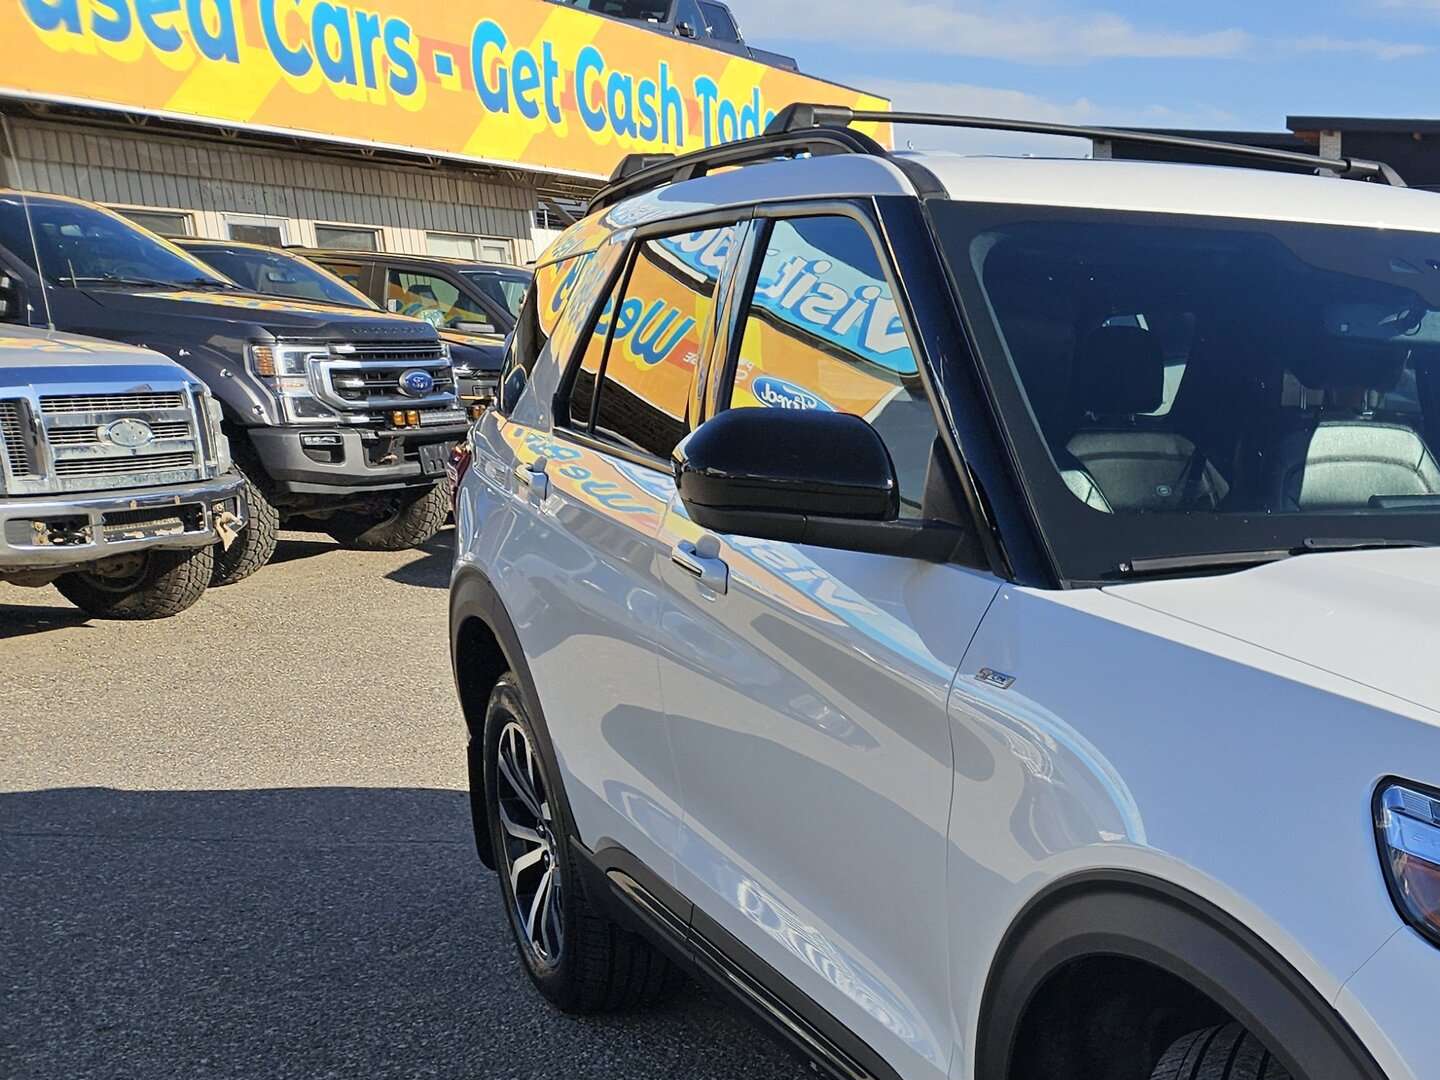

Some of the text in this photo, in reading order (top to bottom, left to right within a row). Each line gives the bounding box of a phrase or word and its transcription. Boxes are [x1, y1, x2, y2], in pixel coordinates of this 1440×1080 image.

[258, 0, 418, 96] Cars
[471, 19, 562, 124] Get
[575, 46, 683, 147] Cash
